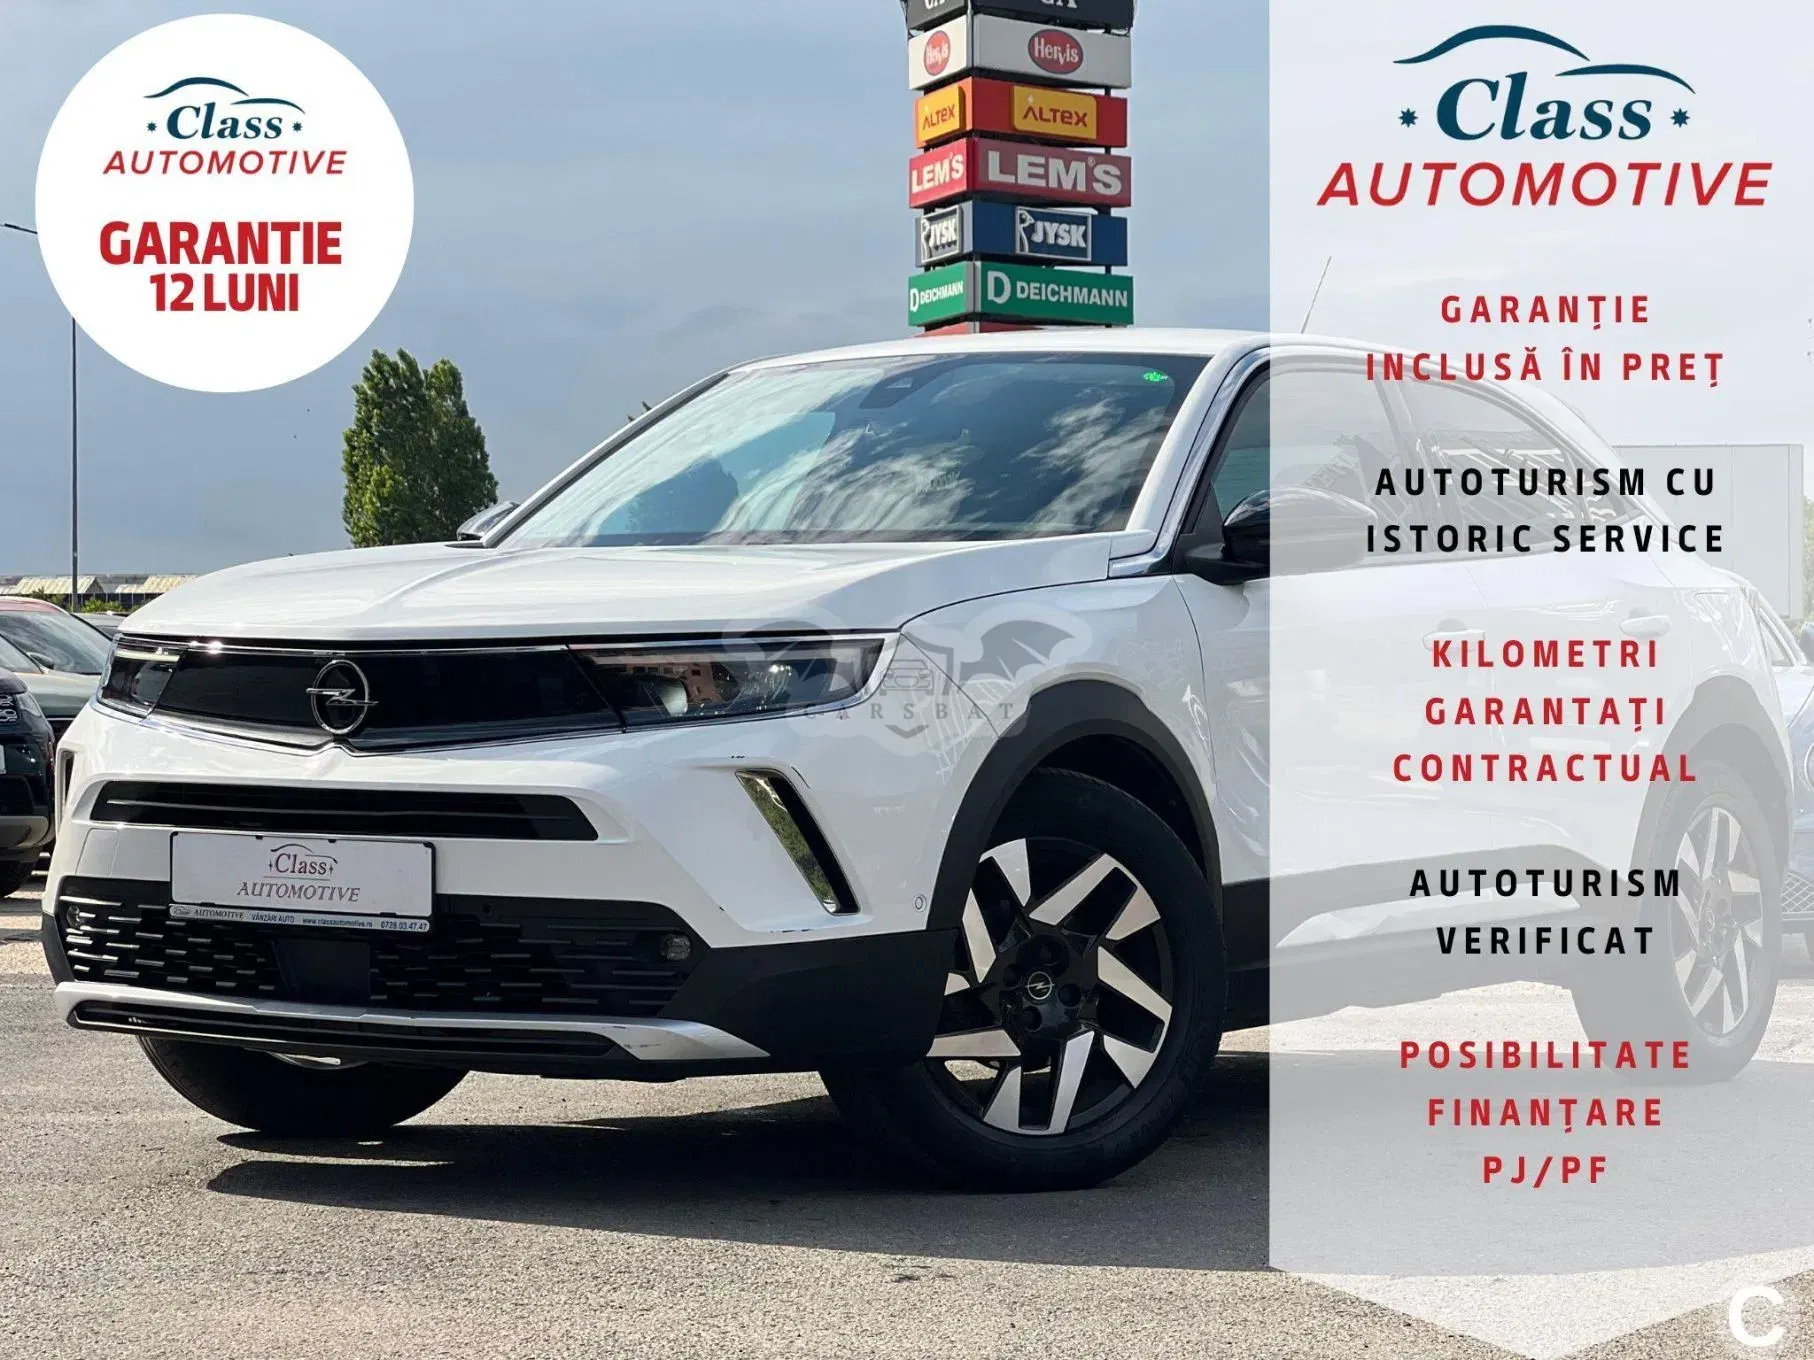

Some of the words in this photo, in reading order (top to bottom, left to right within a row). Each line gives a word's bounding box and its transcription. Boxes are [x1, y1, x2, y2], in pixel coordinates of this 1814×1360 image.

[1034, 37, 1079, 66] Hervis
[929, 218, 957, 247] JYSK
[1031, 220, 1087, 248] JYSK
[920, 281, 964, 304] DEICHMANN
[1016, 281, 1128, 308] DEICHMANN
[275, 853, 327, 875] Class
[237, 882, 360, 902] AUTOMOTIVE
[194, 909, 244, 919] AUTOMOTIVE
